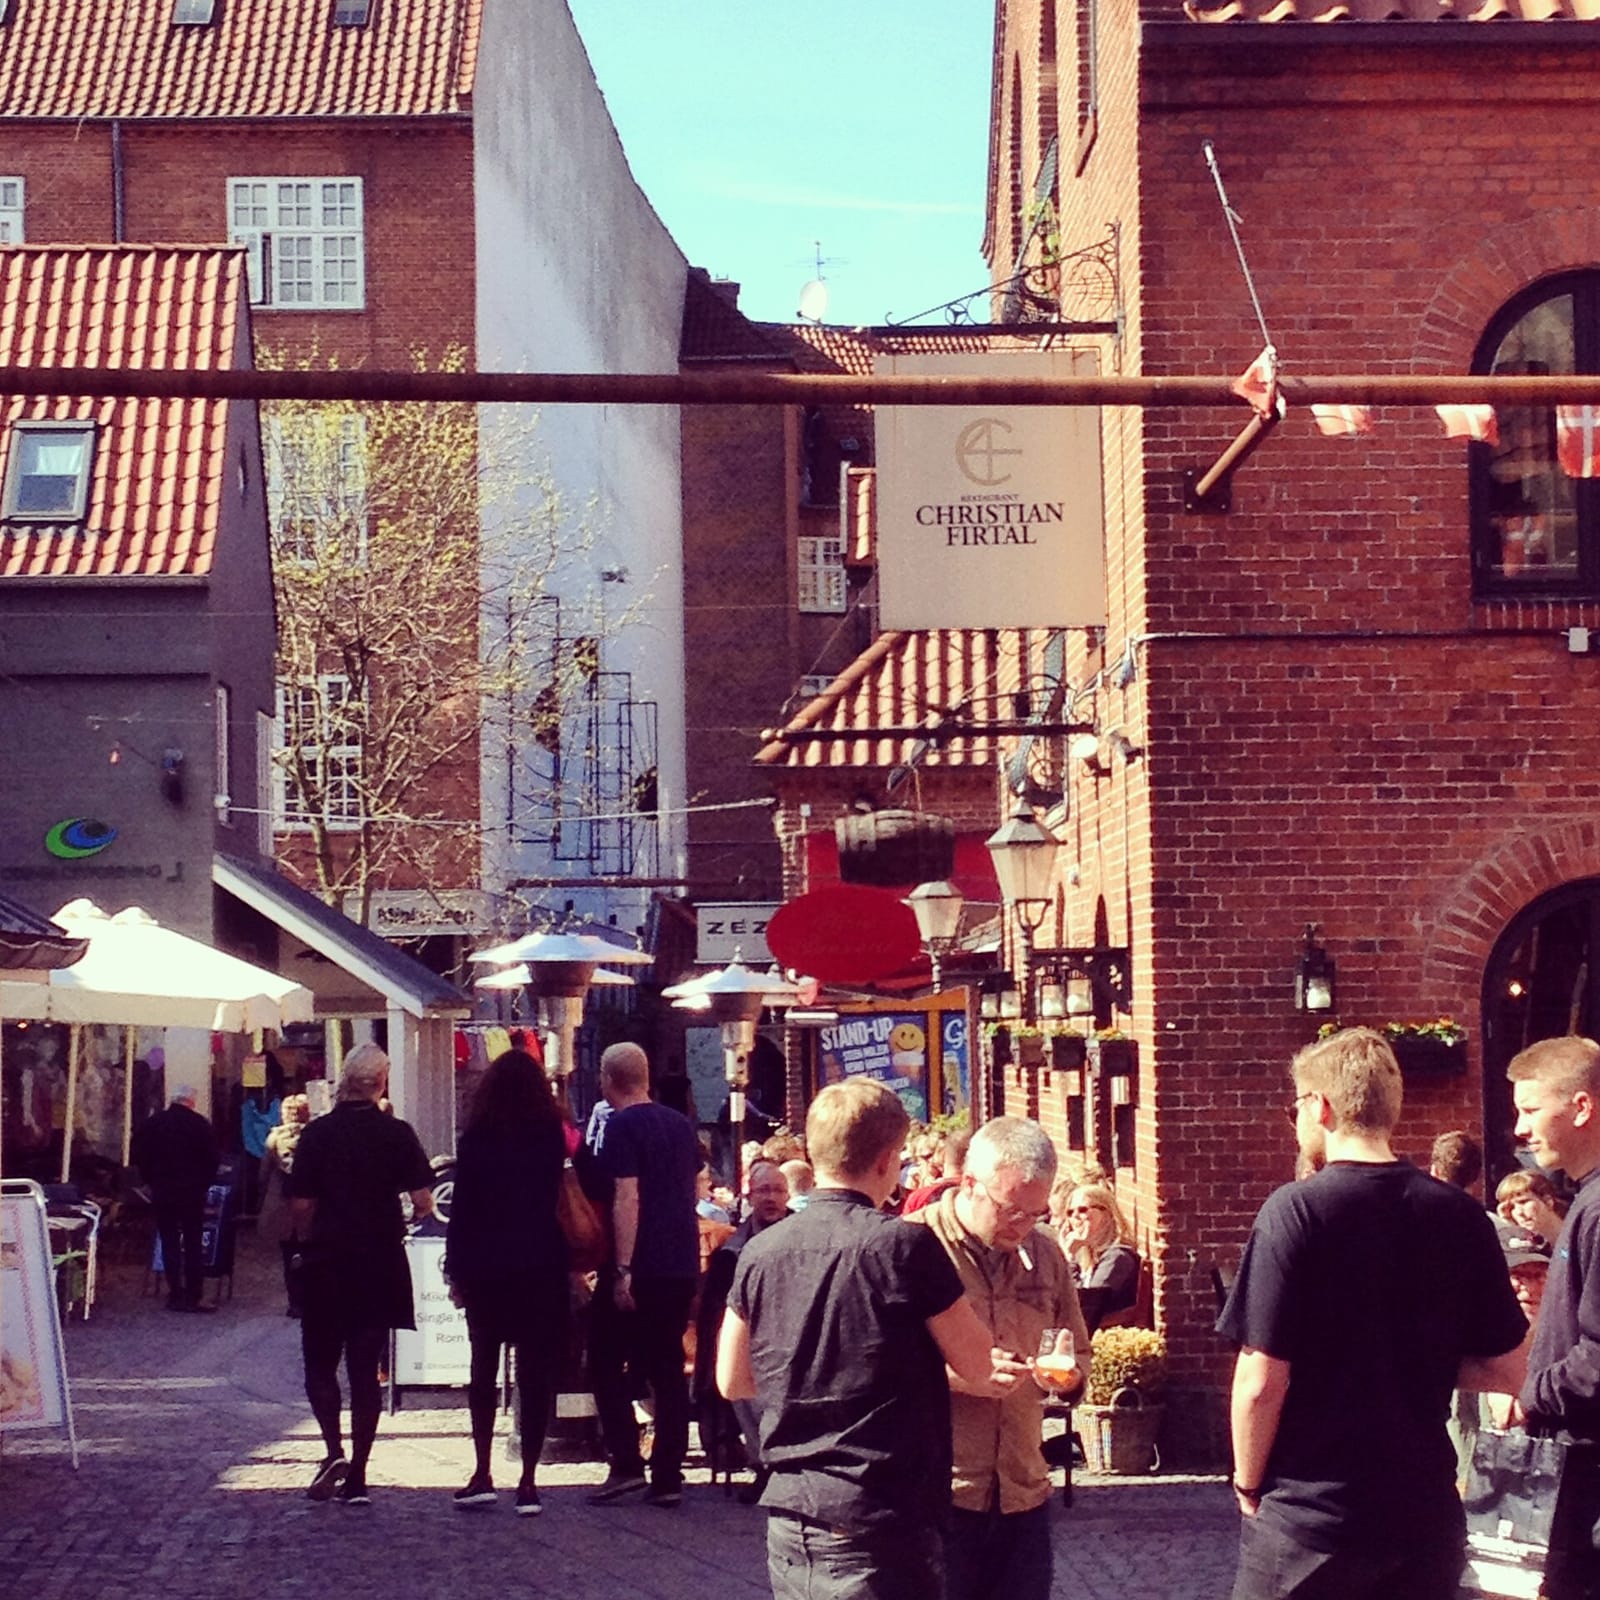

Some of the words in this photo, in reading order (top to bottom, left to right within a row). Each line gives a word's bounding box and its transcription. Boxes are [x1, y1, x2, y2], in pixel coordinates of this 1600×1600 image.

[916, 502, 1065, 526] CHRISTIAN
[946, 525, 1037, 546] FIRTAL
[820, 1017, 893, 1050] STAND-UP
